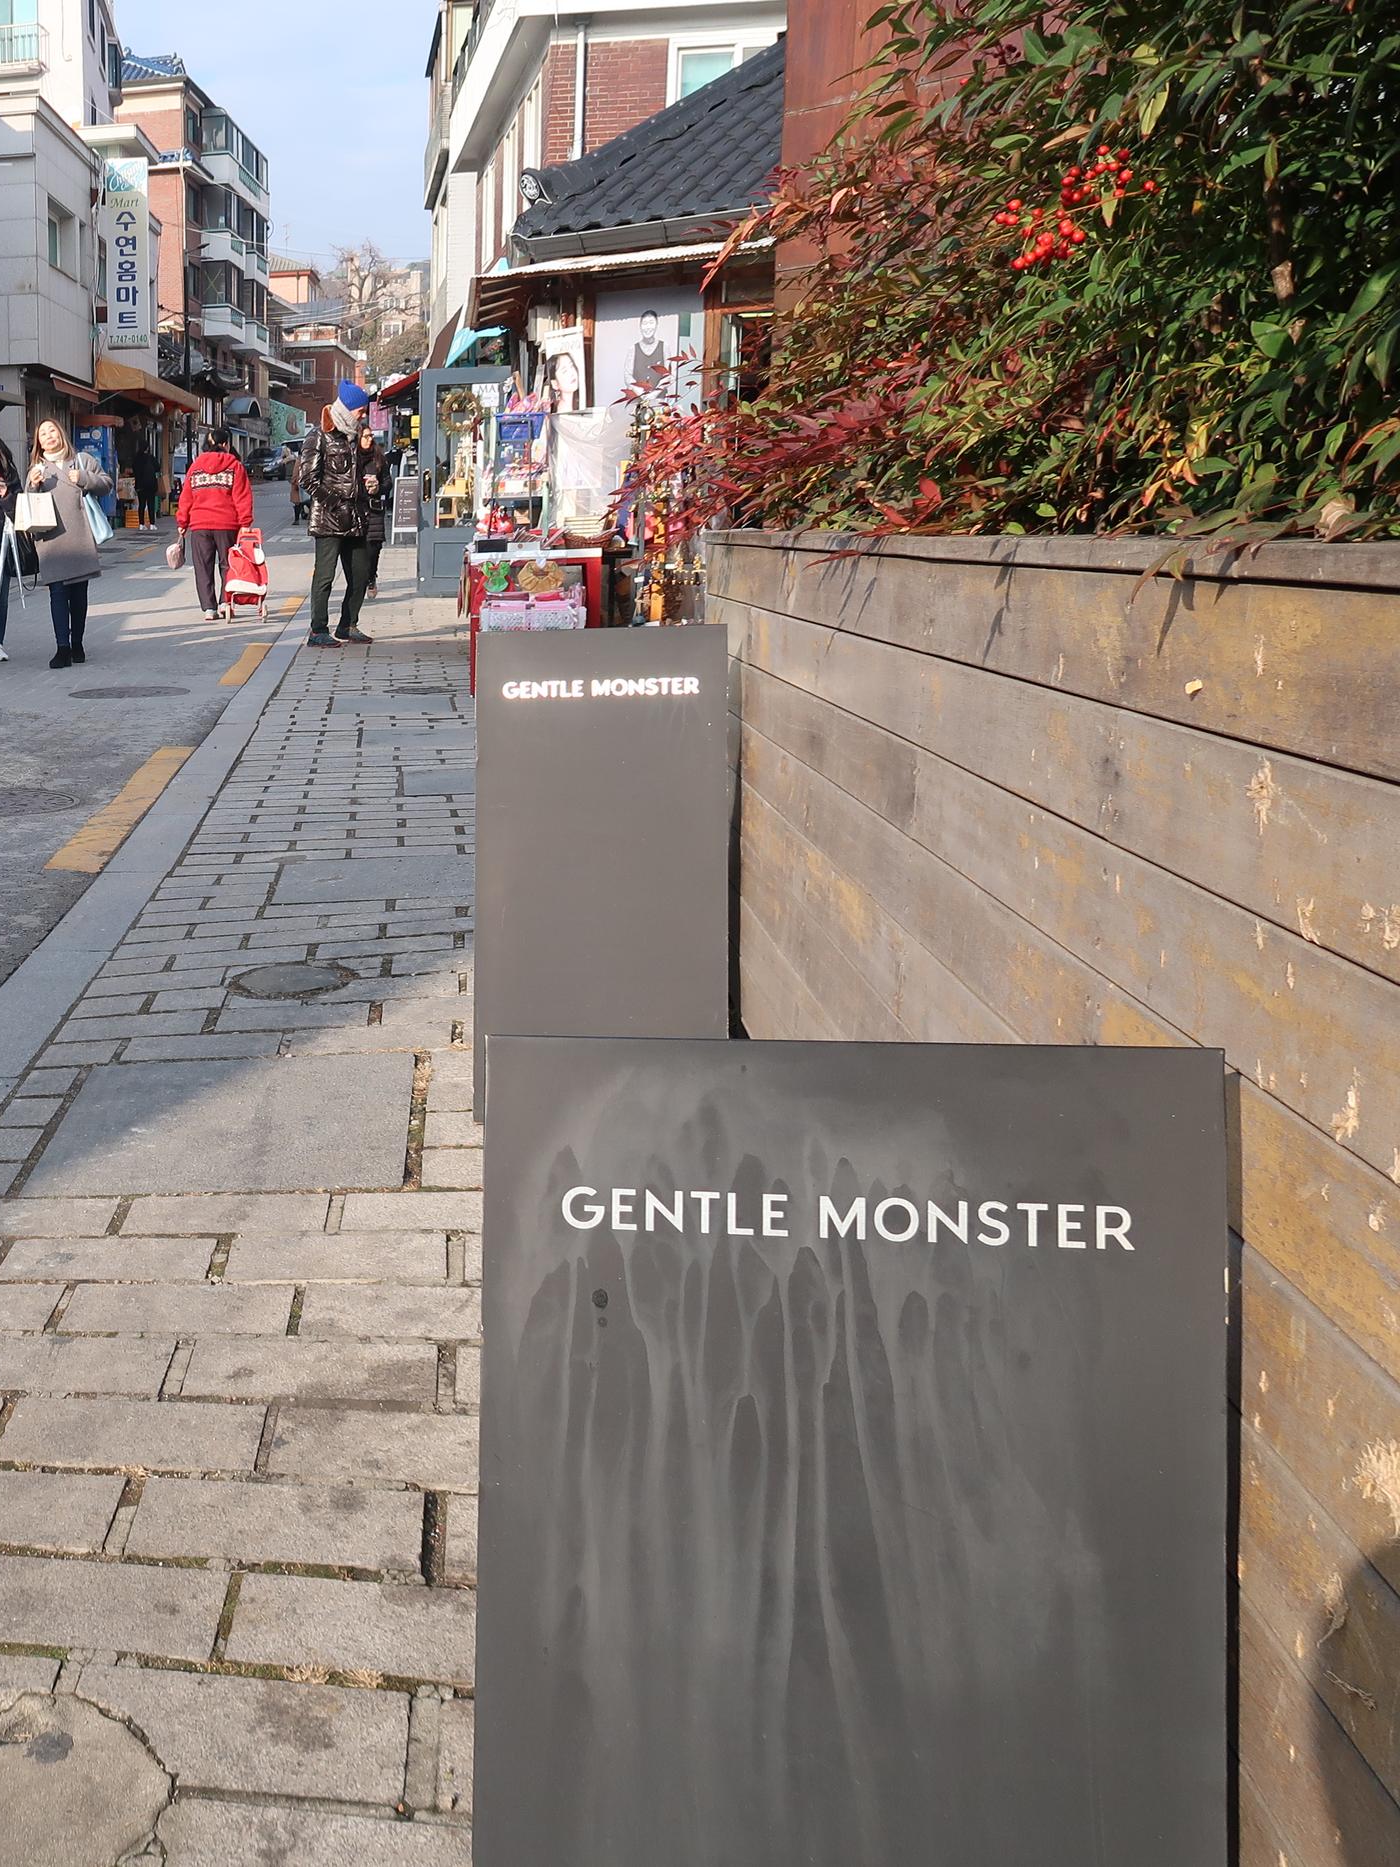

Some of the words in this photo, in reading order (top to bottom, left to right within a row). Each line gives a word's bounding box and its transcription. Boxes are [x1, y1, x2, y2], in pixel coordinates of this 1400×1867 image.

[110, 197, 140, 209] Mart
[115, 211, 139, 329] 수연홈마트
[502, 679, 584, 700] GENTLE
[591, 676, 700, 697] MONSTER
[561, 1186, 789, 1238] GENTLE
[819, 1196, 1135, 1251] MONSTER
